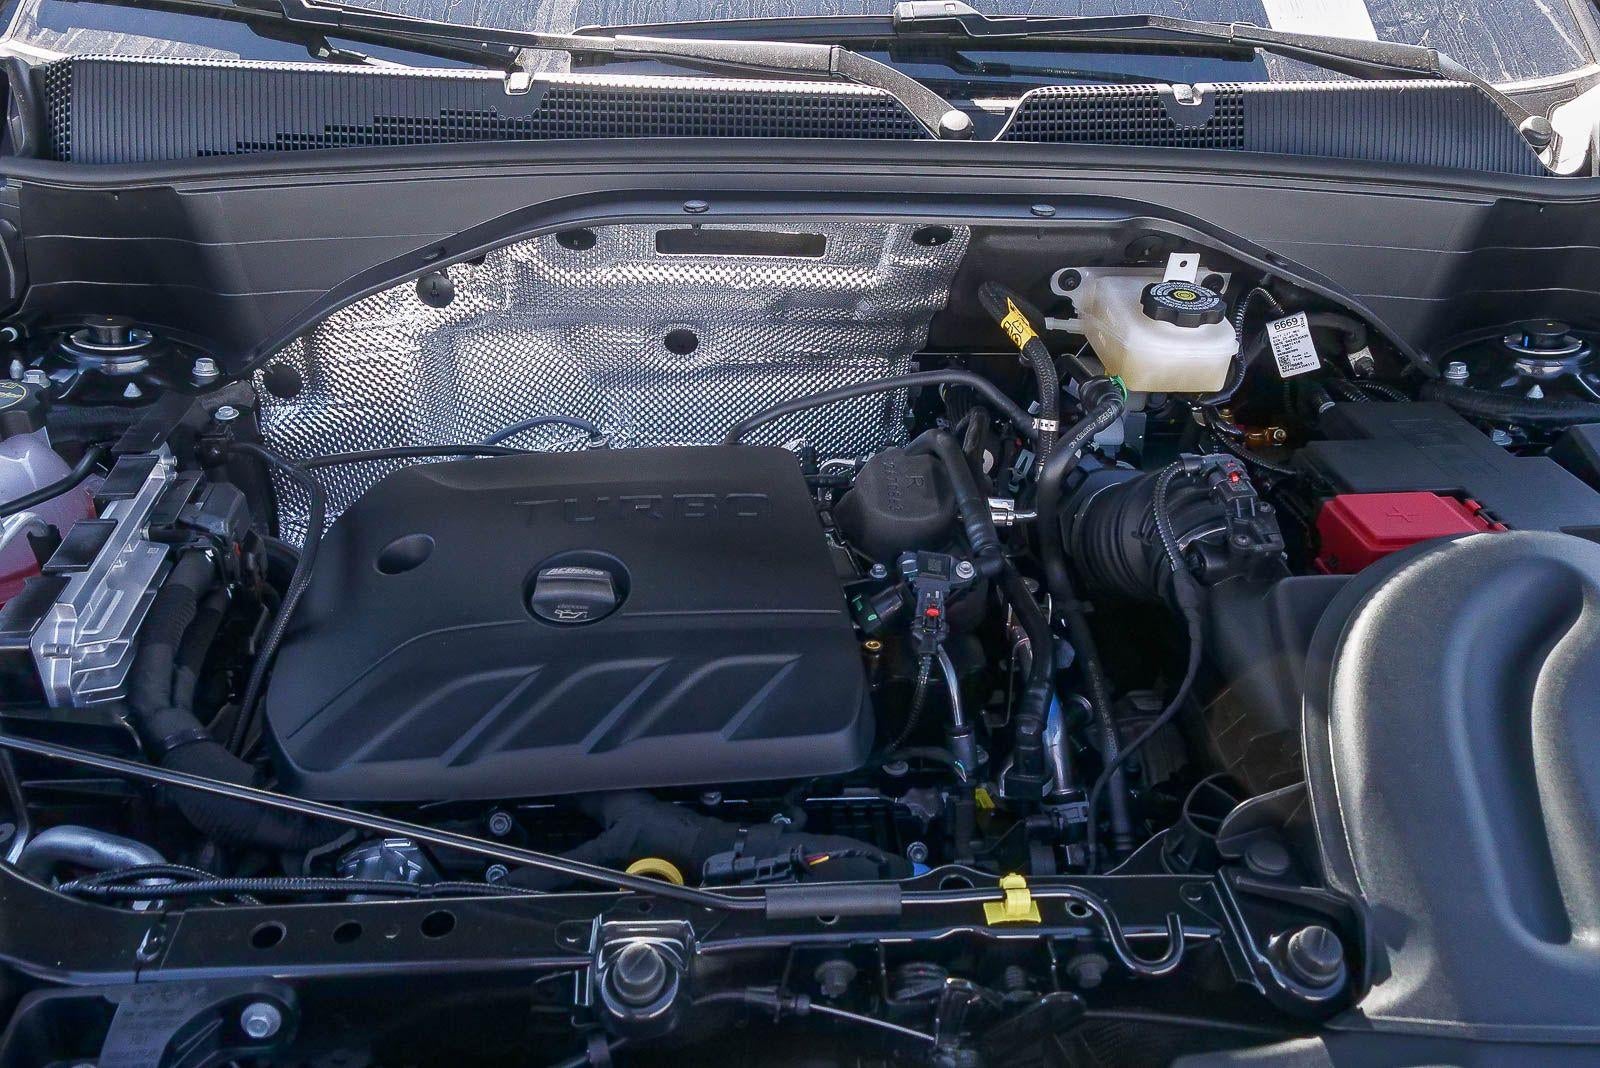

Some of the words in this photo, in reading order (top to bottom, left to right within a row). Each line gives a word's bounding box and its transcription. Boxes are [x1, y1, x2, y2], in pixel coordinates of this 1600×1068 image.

[1274, 318, 1298, 330] 6669
[513, 493, 769, 525] TURBO
[546, 567, 605, 575] ACDelco
